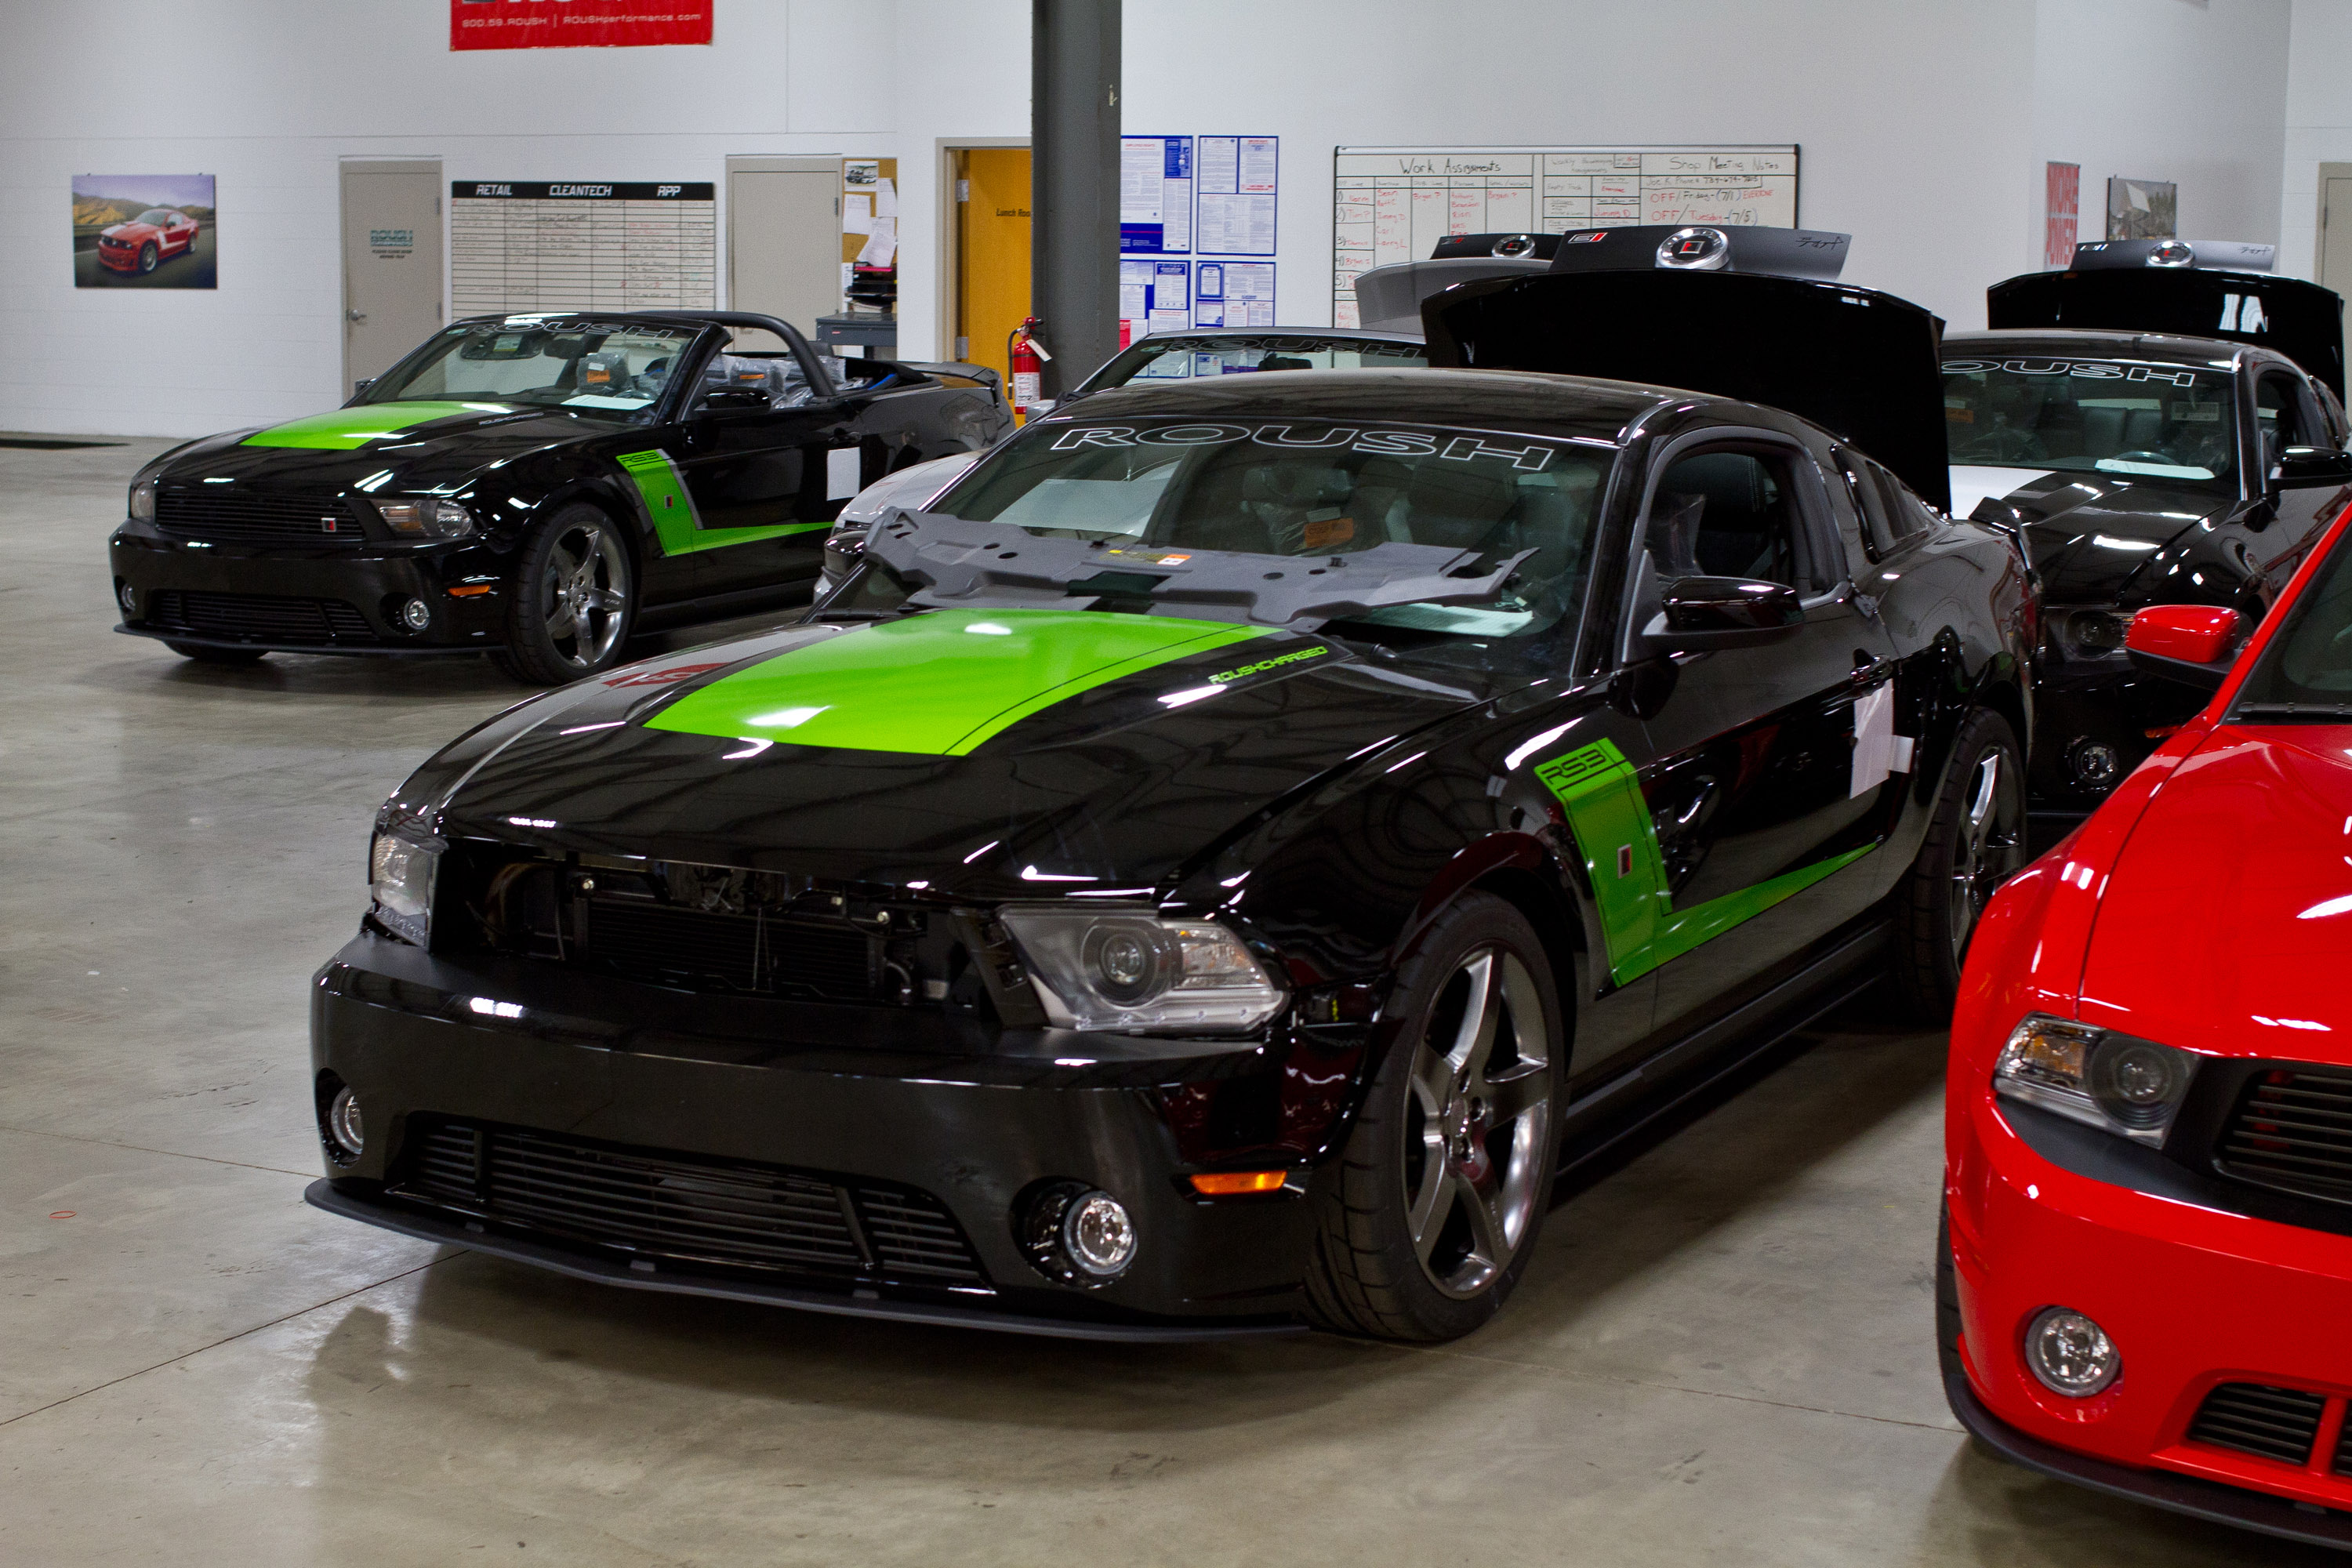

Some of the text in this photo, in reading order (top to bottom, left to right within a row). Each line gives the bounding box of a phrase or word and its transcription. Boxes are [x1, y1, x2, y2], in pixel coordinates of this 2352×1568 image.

[1399, 158, 1436, 174] Work
[1708, 156, 1744, 172] Meeting
[1753, 158, 1780, 171] Notes
[476, 185, 513, 195] RETAIL
[550, 185, 612, 196] CLEANTECH
[657, 186, 681, 197] APP
[996, 208, 1031, 217] Lunch Roo
[460, 321, 674, 340] ROUSH
[1158, 338, 1422, 359] ROUSH
[1940, 359, 2196, 387] OUSH
[1051, 424, 1554, 470] ROUSH
[619, 452, 659, 464] RS3
[1208, 645, 1329, 685] ROUSHCHARGED
[1541, 749, 1607, 785] RS3
